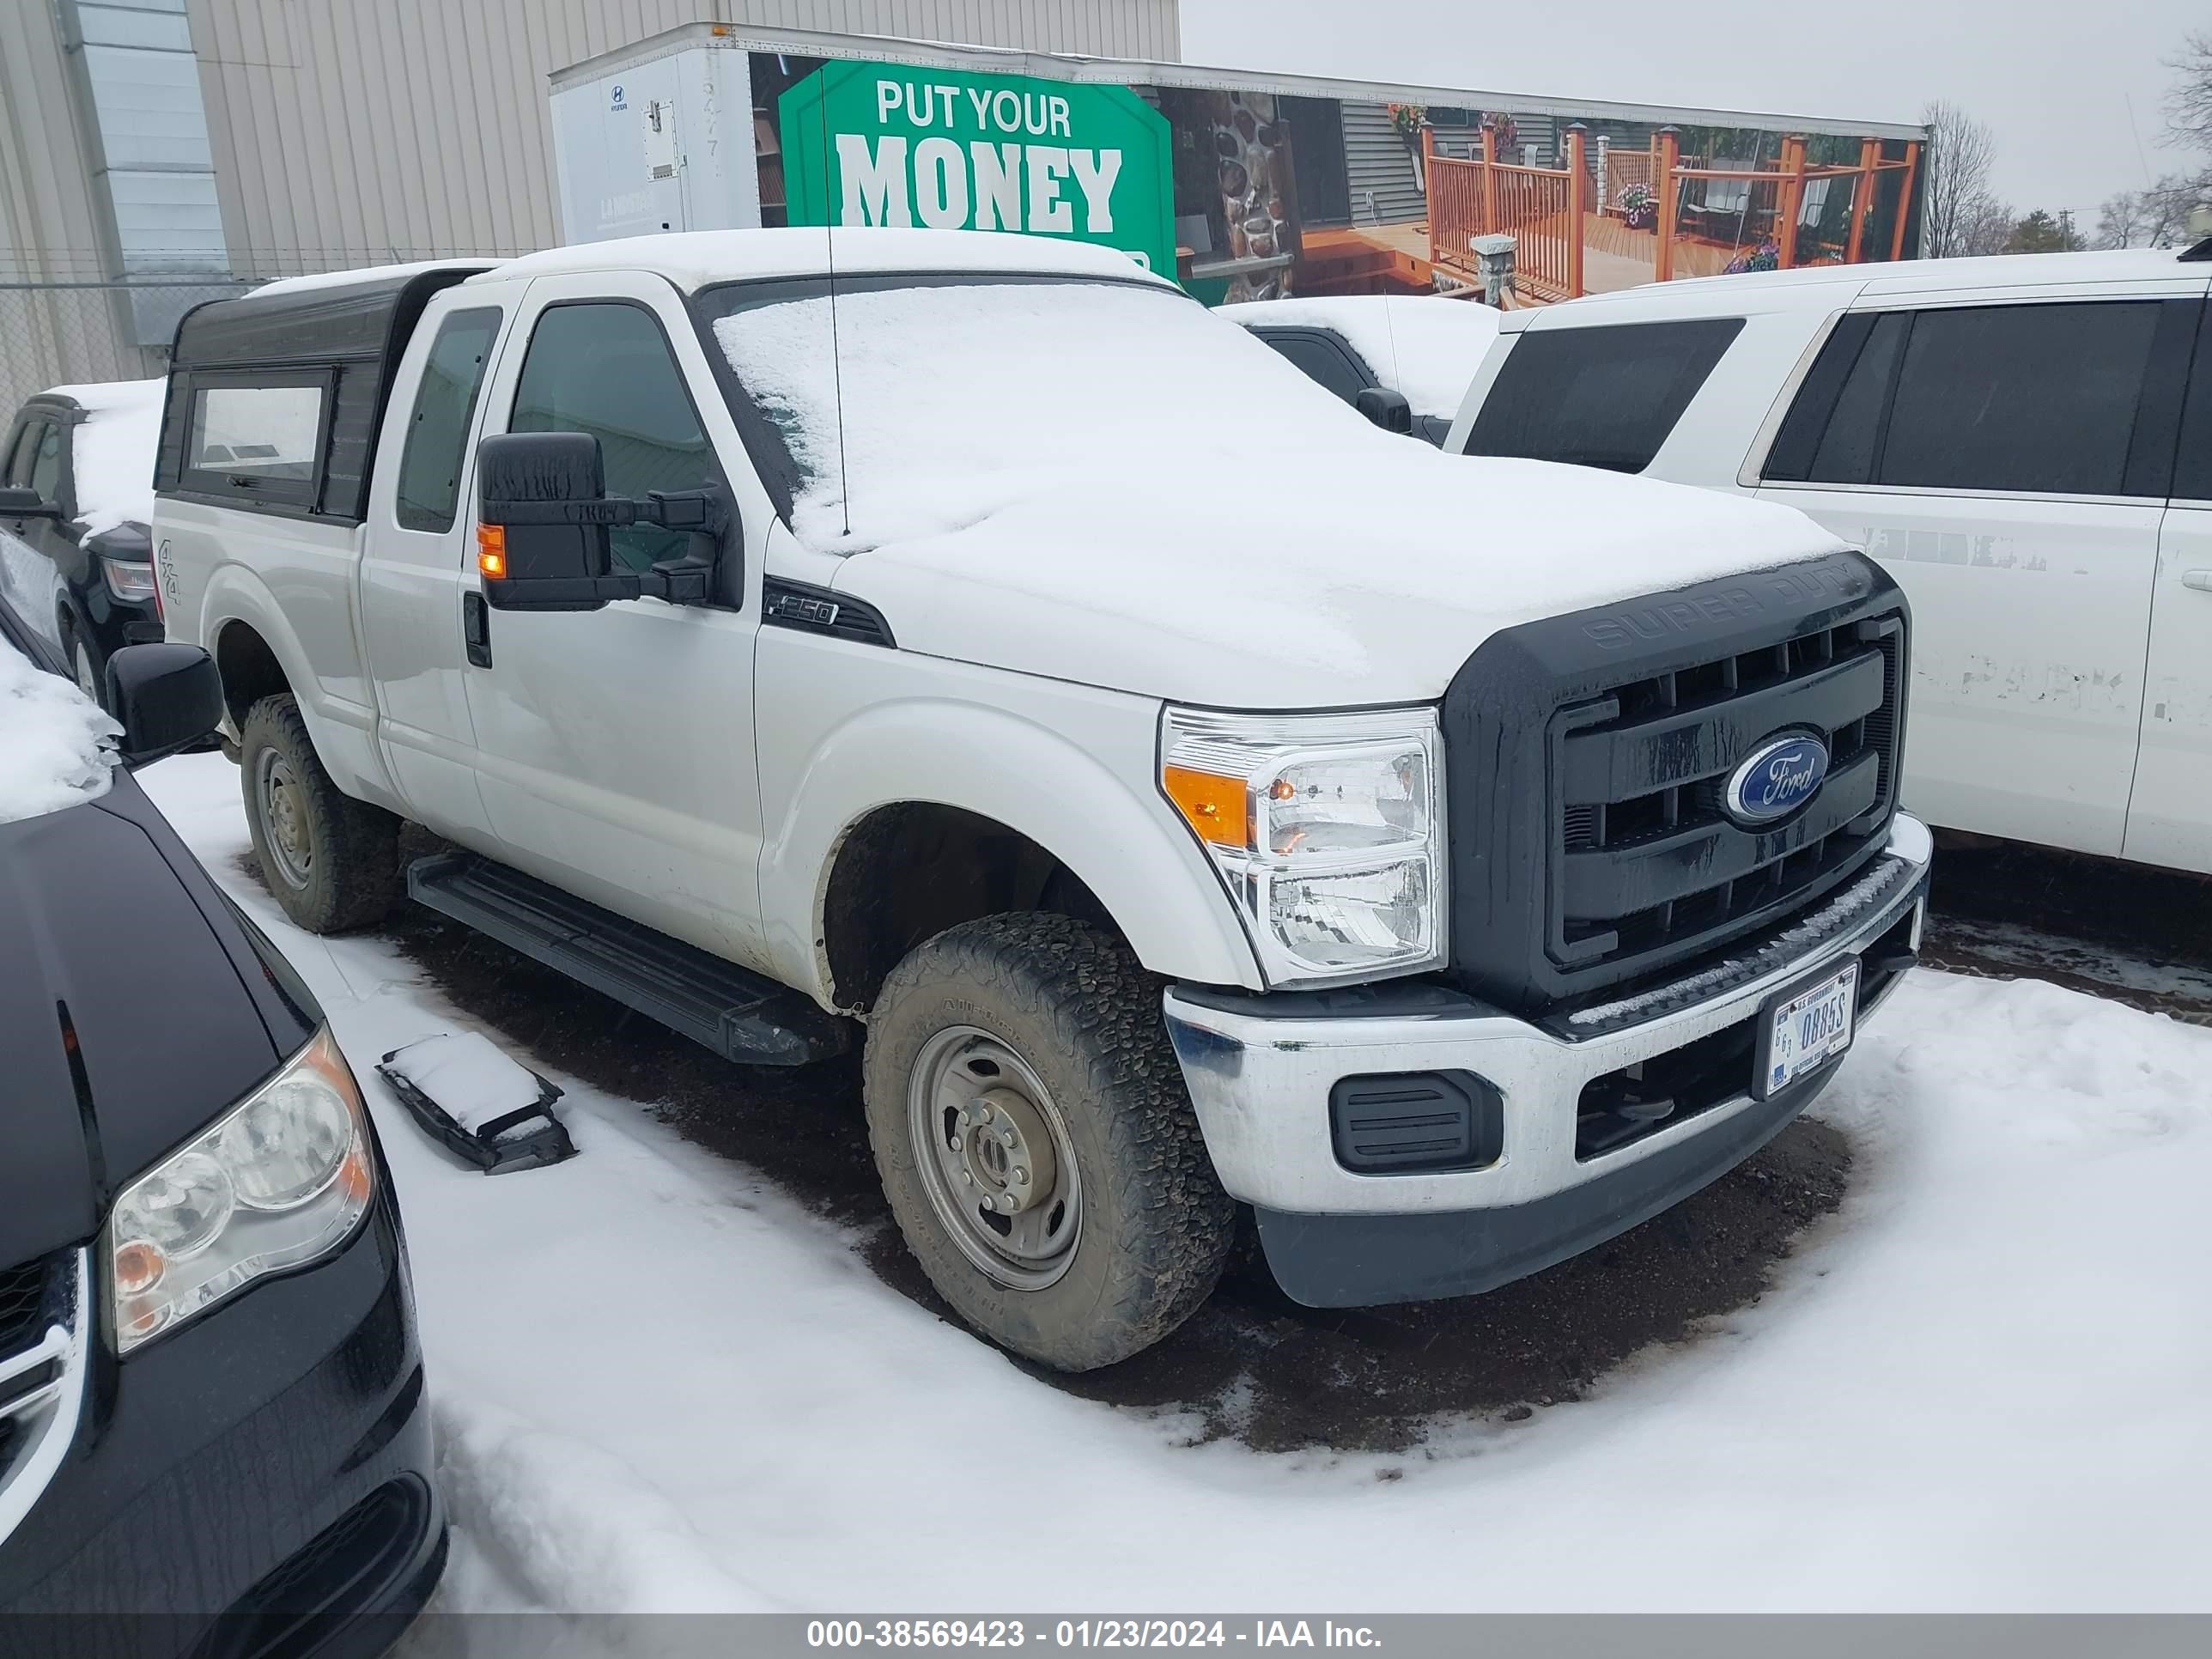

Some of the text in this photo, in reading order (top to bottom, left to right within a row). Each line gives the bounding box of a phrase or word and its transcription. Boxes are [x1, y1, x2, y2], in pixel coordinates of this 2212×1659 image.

[876, 79, 1072, 138] PUT YOUR
[835, 133, 1123, 234] MONEY
[1584, 560, 1855, 650] SUPER DUTY
[1762, 752, 1815, 805] Ford
[1802, 992, 1845, 1051] 0885S
